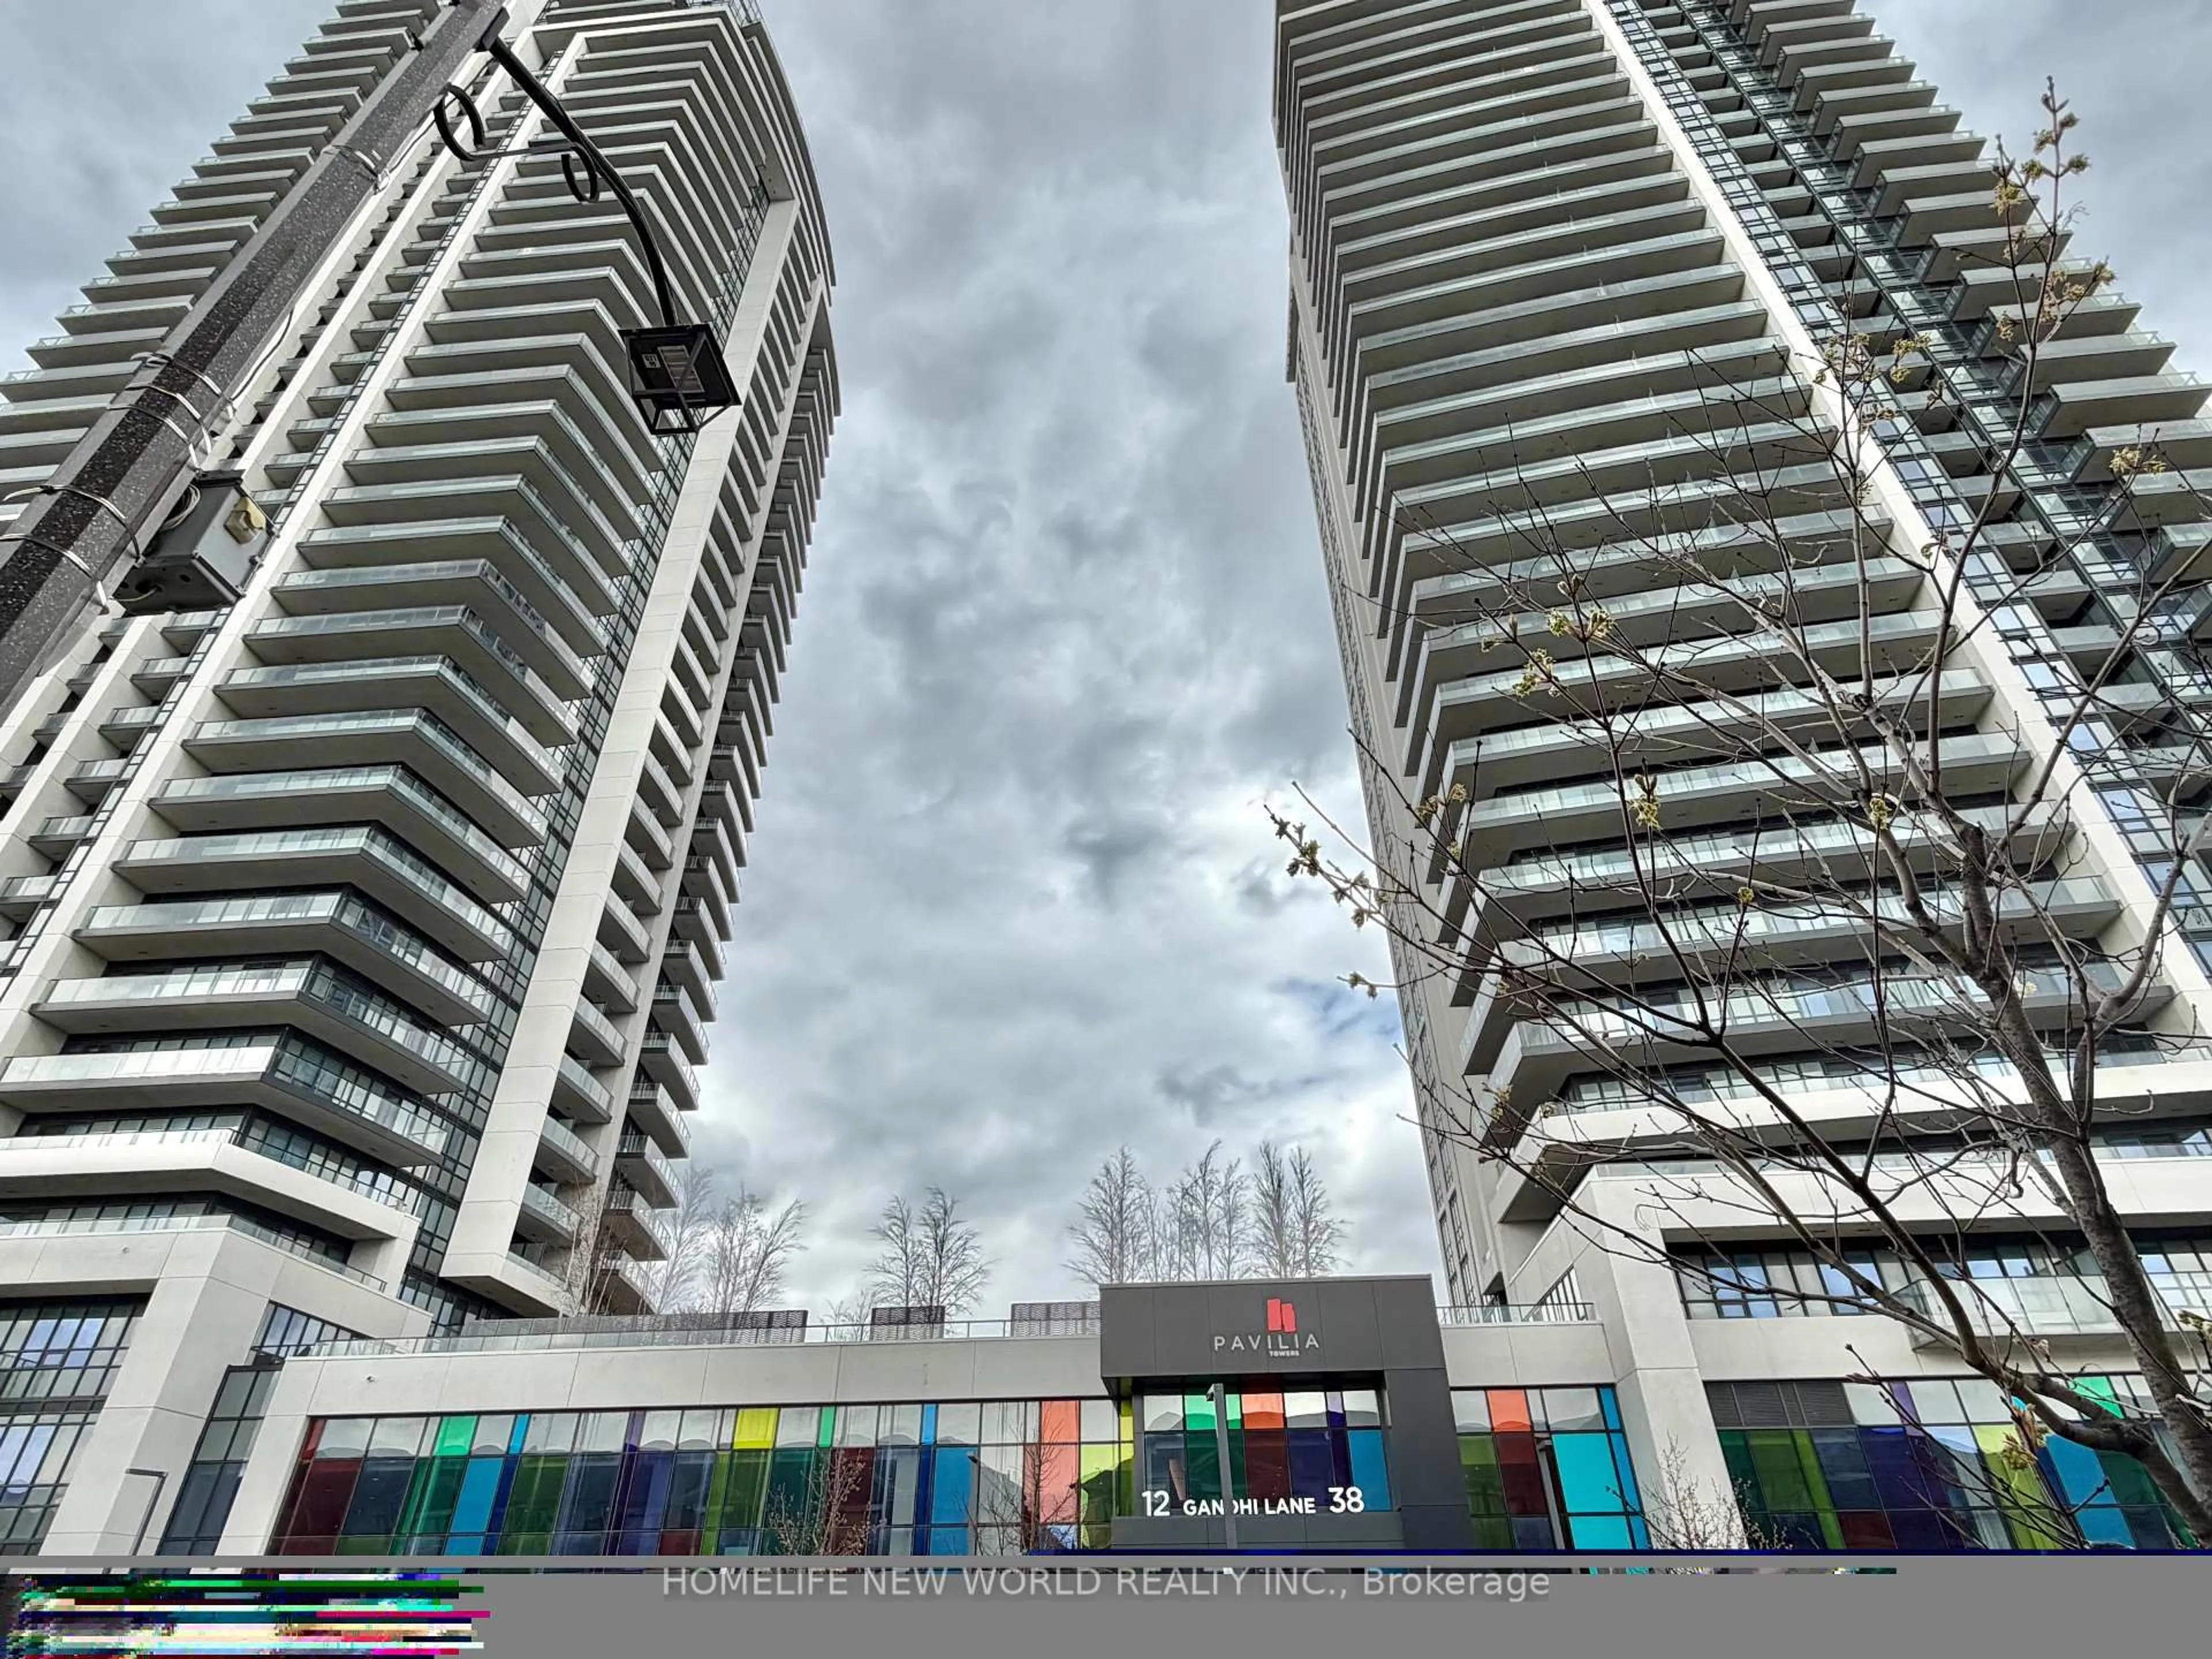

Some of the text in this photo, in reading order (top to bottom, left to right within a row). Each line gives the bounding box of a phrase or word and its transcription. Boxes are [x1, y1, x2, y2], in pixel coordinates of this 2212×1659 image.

[1214, 1334, 1319, 1351] PAVILIA
[1142, 1490, 1171, 1517] 12
[1264, 1498, 1316, 1515] LANE
[1328, 1486, 1365, 1513] 38
